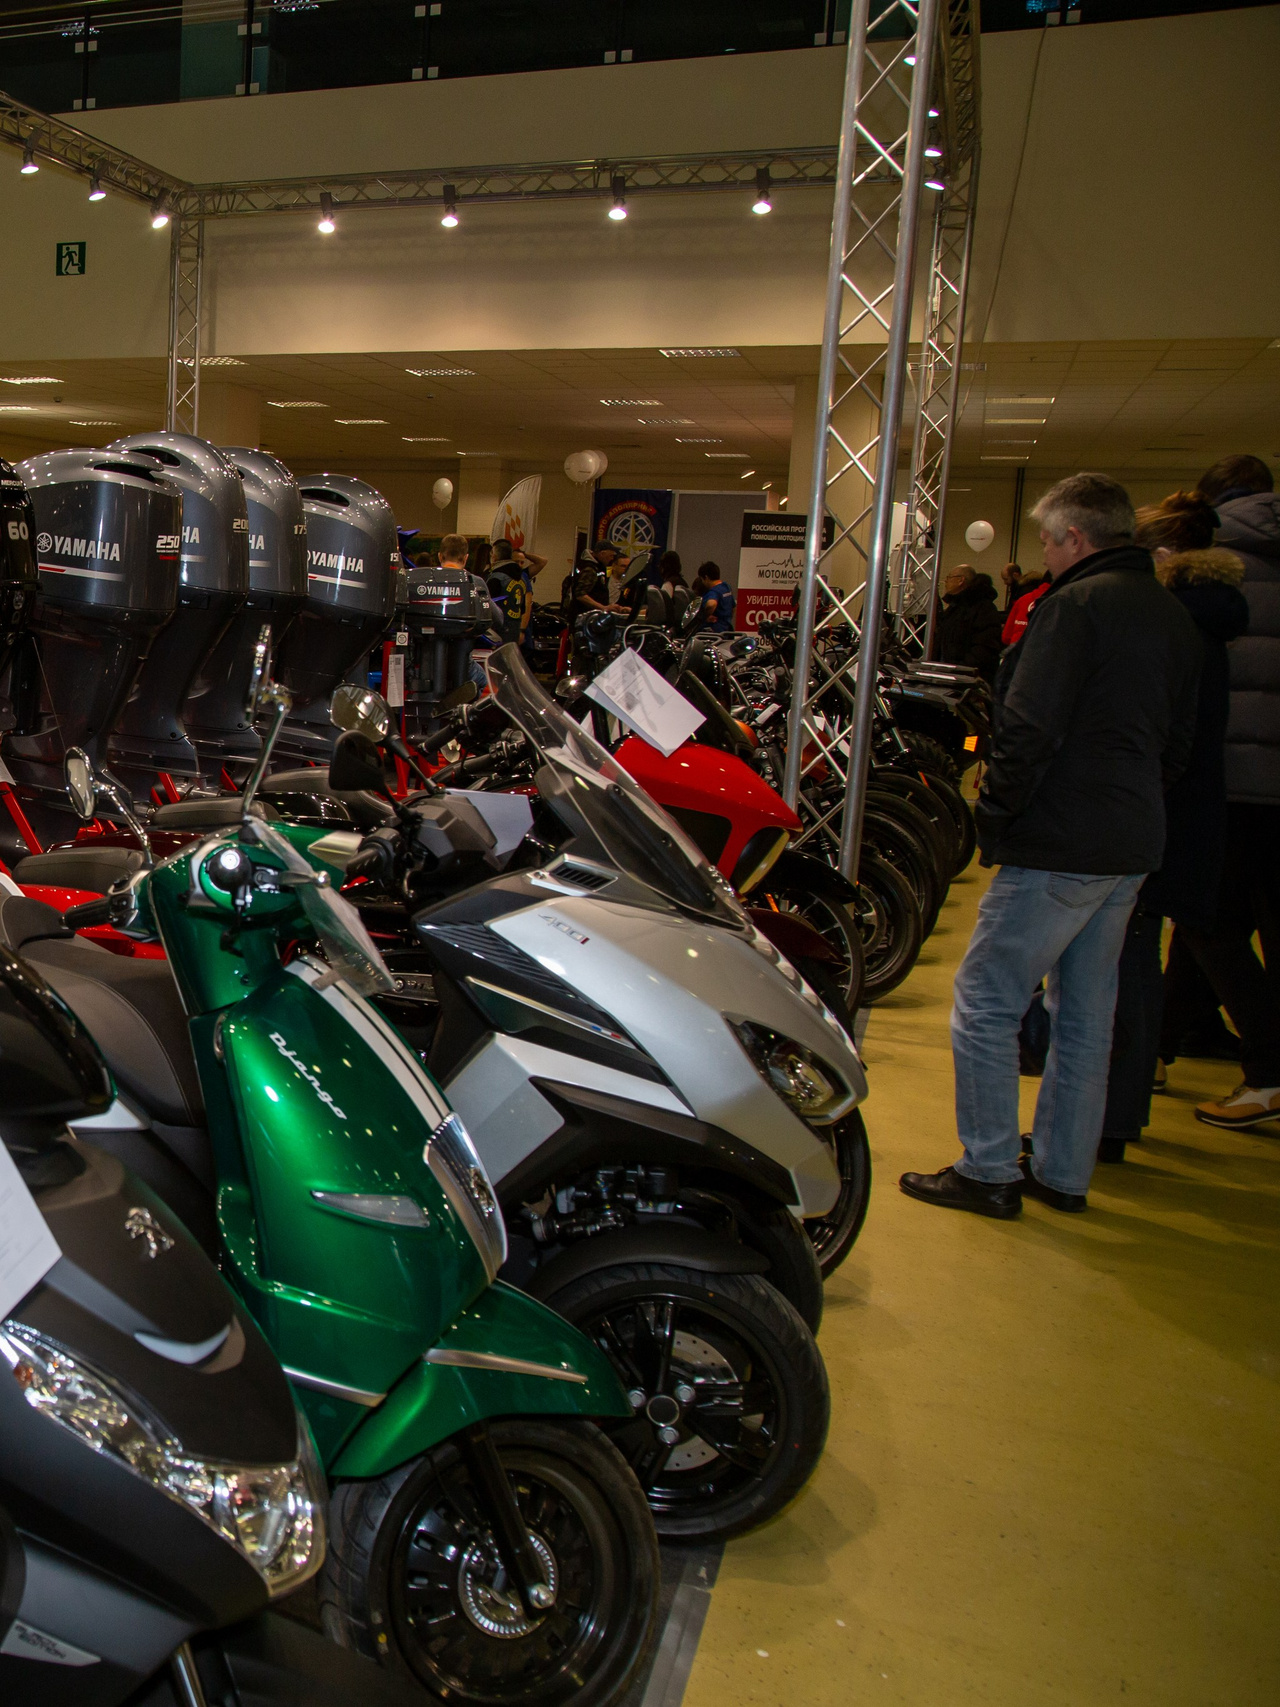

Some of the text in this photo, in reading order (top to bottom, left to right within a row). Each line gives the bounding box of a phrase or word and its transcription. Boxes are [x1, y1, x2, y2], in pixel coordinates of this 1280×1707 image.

[233, 519, 248, 529] 20
[751, 524, 790, 532] РОССИЙСКАЯ
[7, 522, 29, 540] 60
[156, 535, 180, 548] 250
[54, 536, 120, 561] YAMAHA
[312, 551, 364, 573] YAMAHA
[757, 570, 803, 579] МОТОМОСК
[427, 586, 461, 596] YAMAHA
[746, 595, 779, 606] УВИДЕЛ
[745, 610, 795, 626] СООБ
[269, 1032, 348, 1120] Django
